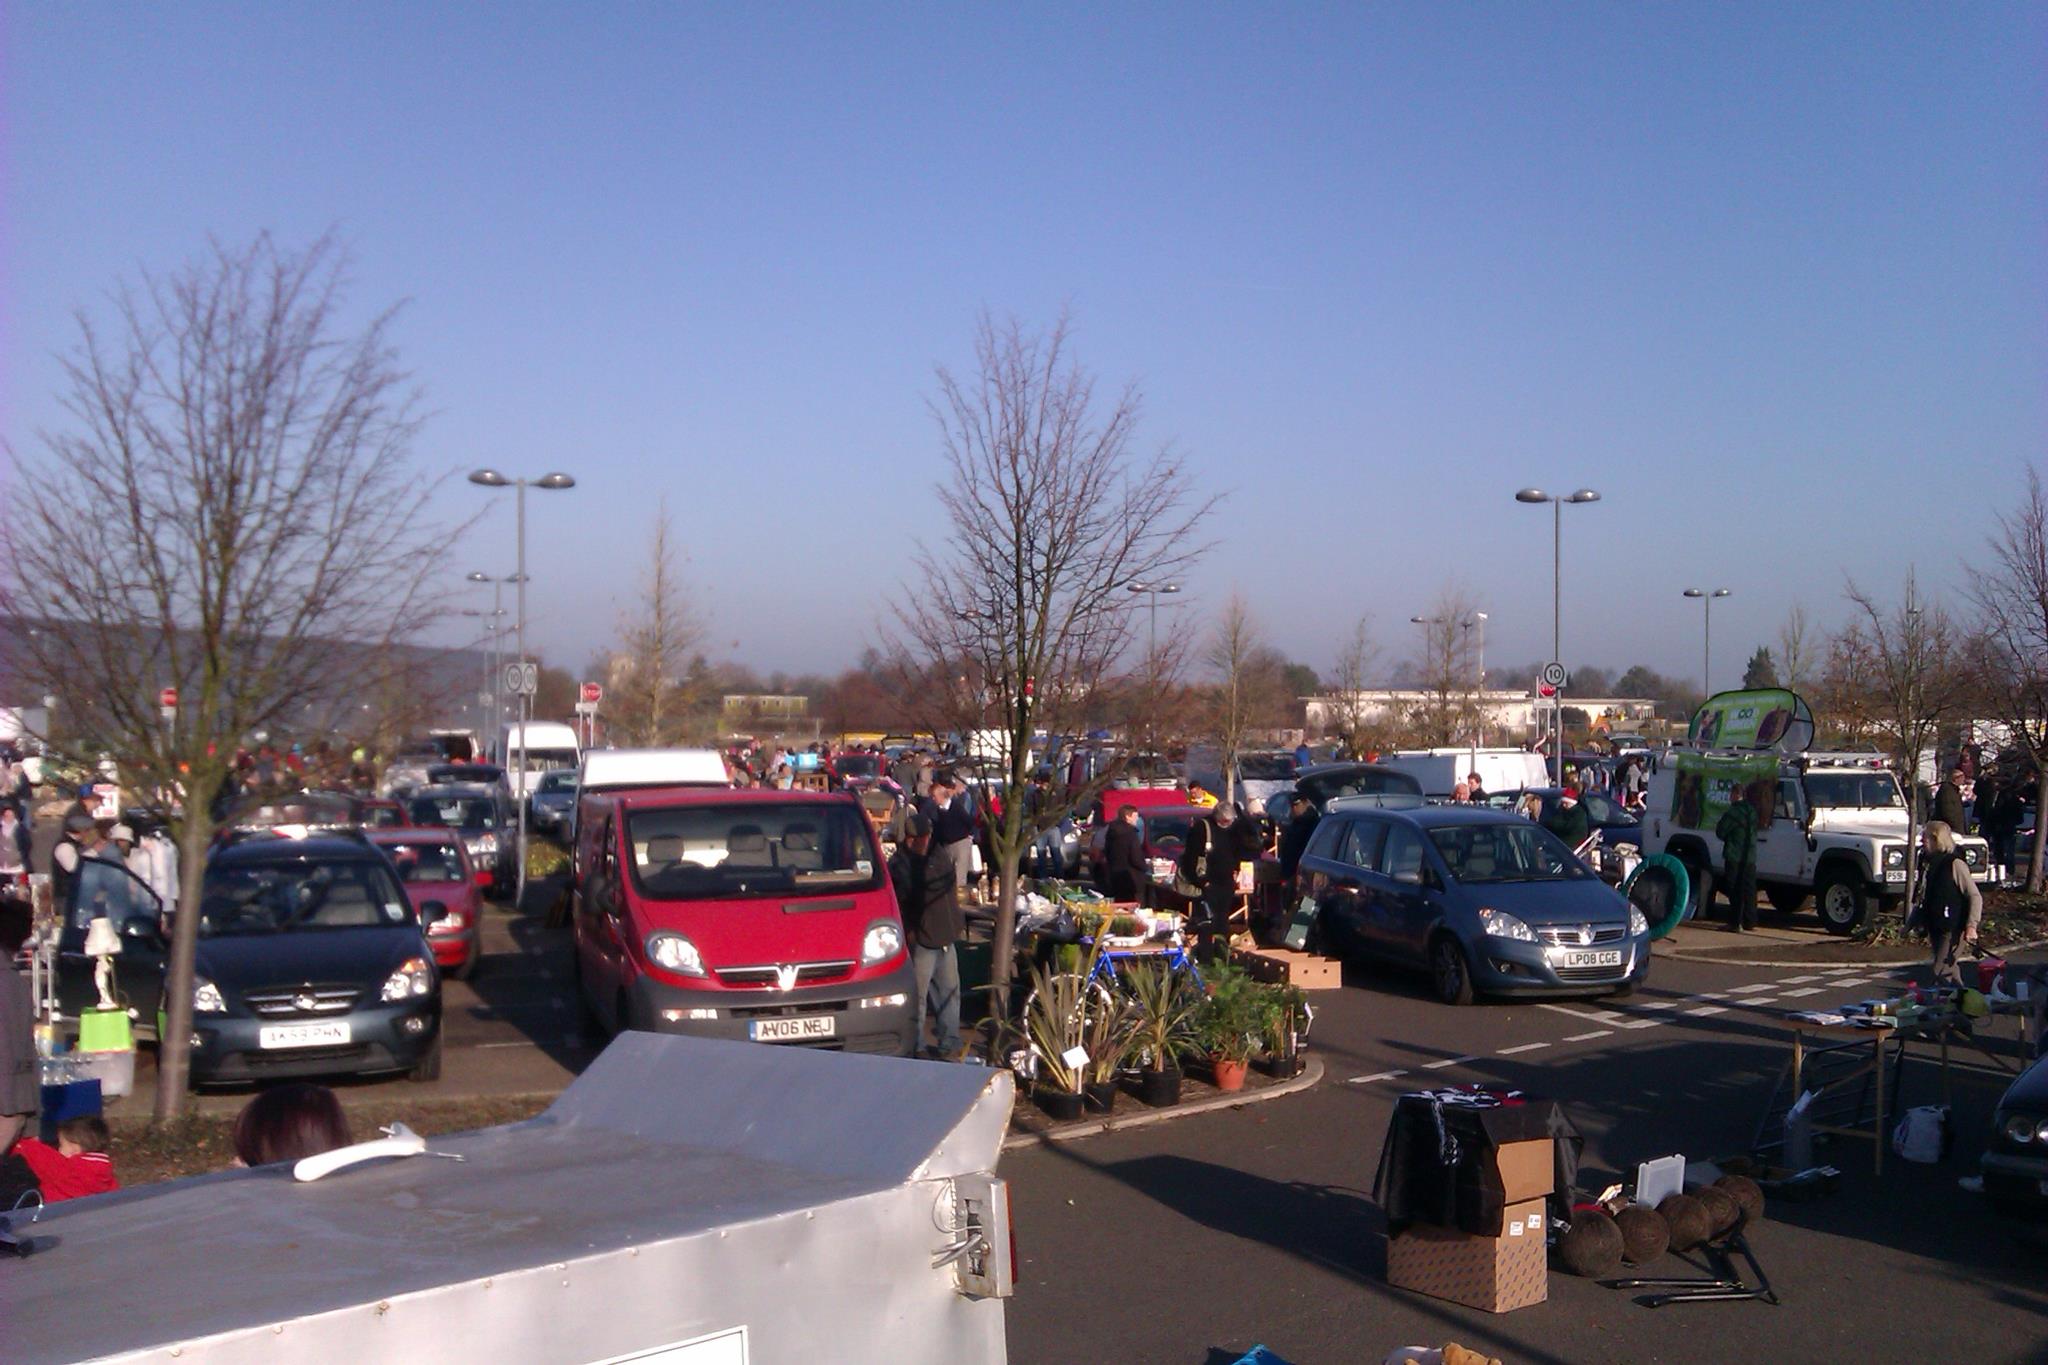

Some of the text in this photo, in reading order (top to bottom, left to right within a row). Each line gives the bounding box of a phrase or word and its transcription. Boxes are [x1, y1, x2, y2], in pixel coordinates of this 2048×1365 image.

[1549, 669, 1561, 680] 10
[1569, 952, 1618, 966] LP08 CGE
[761, 1018, 832, 1038] AV06 NEJ
